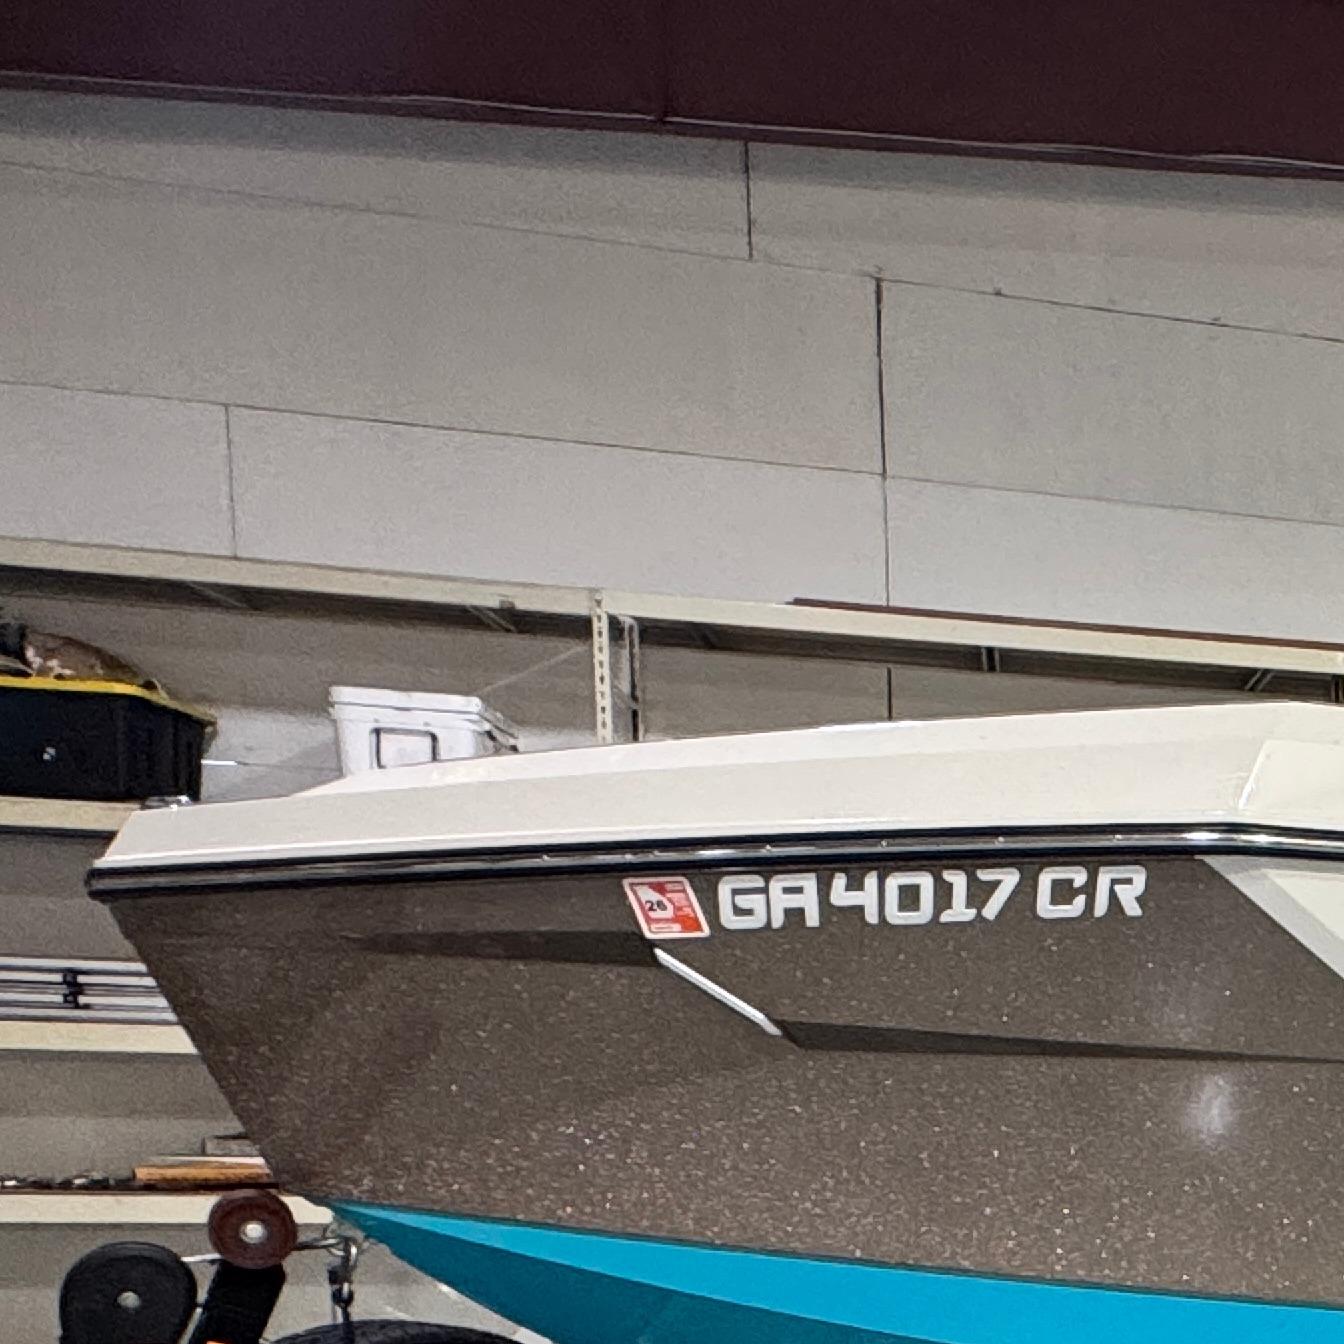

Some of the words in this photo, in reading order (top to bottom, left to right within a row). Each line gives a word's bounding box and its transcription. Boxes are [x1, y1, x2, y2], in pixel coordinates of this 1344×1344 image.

[717, 873, 820, 930] GA
[829, 868, 1021, 926] 4017
[1036, 865, 1148, 920] CR
